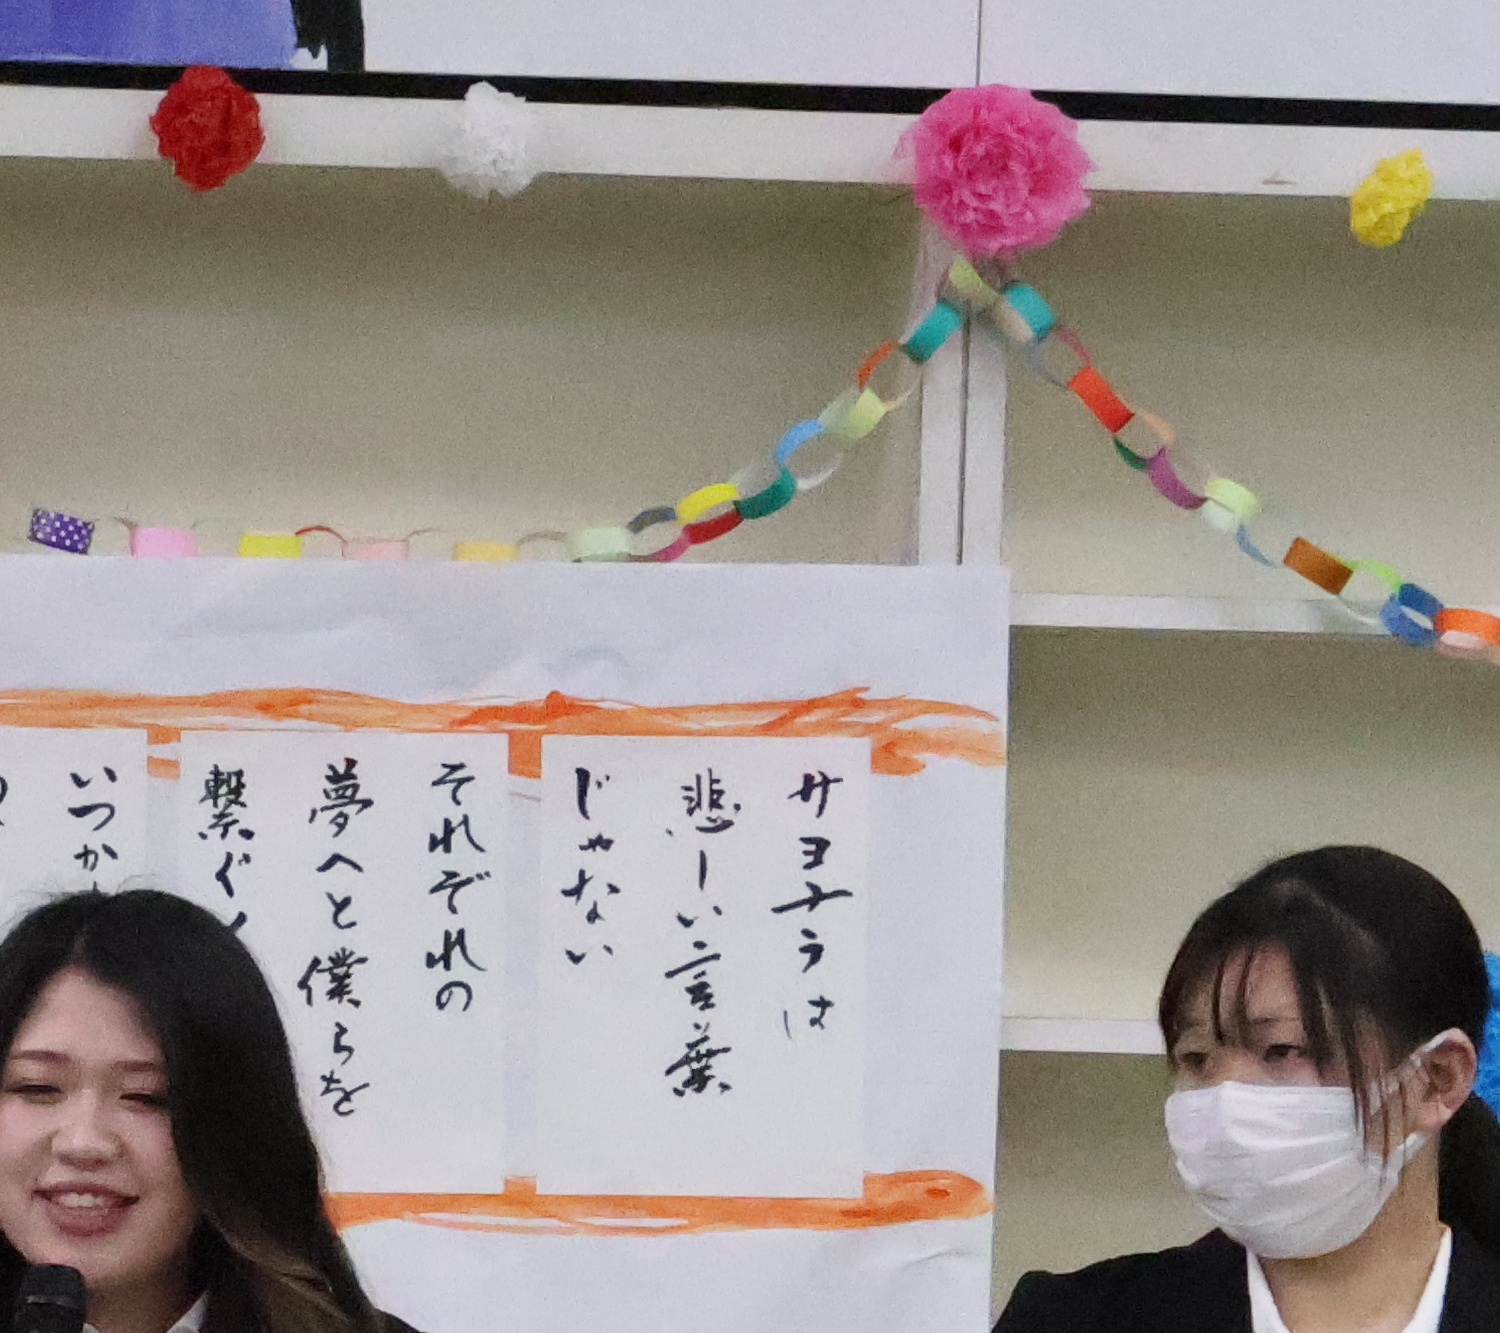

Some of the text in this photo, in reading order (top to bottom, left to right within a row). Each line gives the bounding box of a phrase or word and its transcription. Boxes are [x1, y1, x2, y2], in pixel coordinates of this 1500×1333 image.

[68, 766, 118, 895] いつか
[198, 764, 255, 935] 繋ぐ
[297, 757, 374, 1116] 夢へと僕らを
[426, 762, 491, 1011] それぞれの
[561, 767, 621, 965] じゃない
[665, 768, 741, 1097] 悲しい言葉
[771, 770, 853, 1039] サヨナラは
